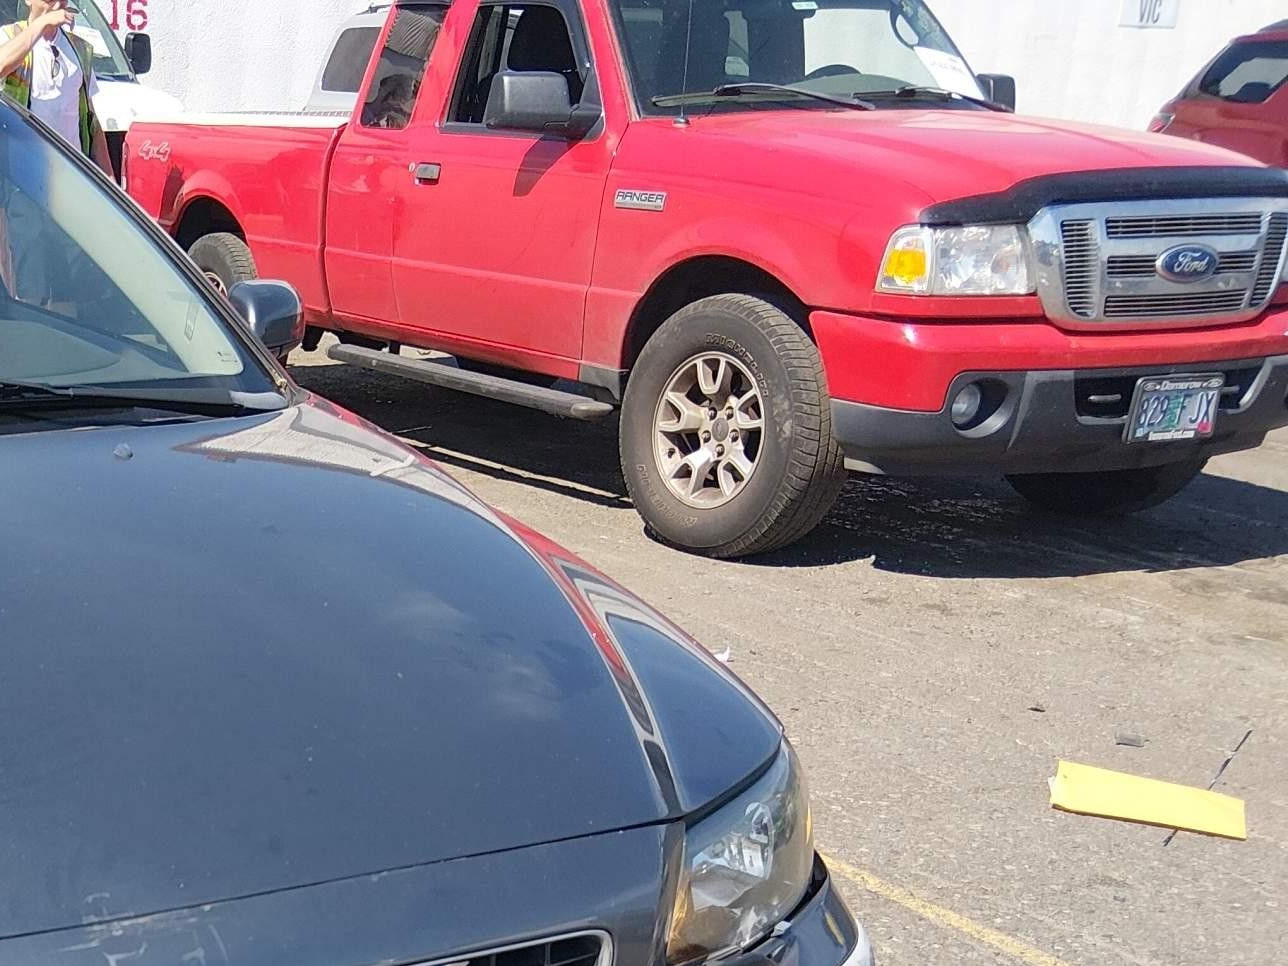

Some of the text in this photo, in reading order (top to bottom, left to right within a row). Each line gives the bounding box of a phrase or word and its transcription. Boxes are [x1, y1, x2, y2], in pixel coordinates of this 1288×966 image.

[109, 0, 148, 31] 16
[616, 191, 664, 203] RANGER
[1174, 251, 1210, 273] Ford
[1139, 396, 1170, 427] 829
